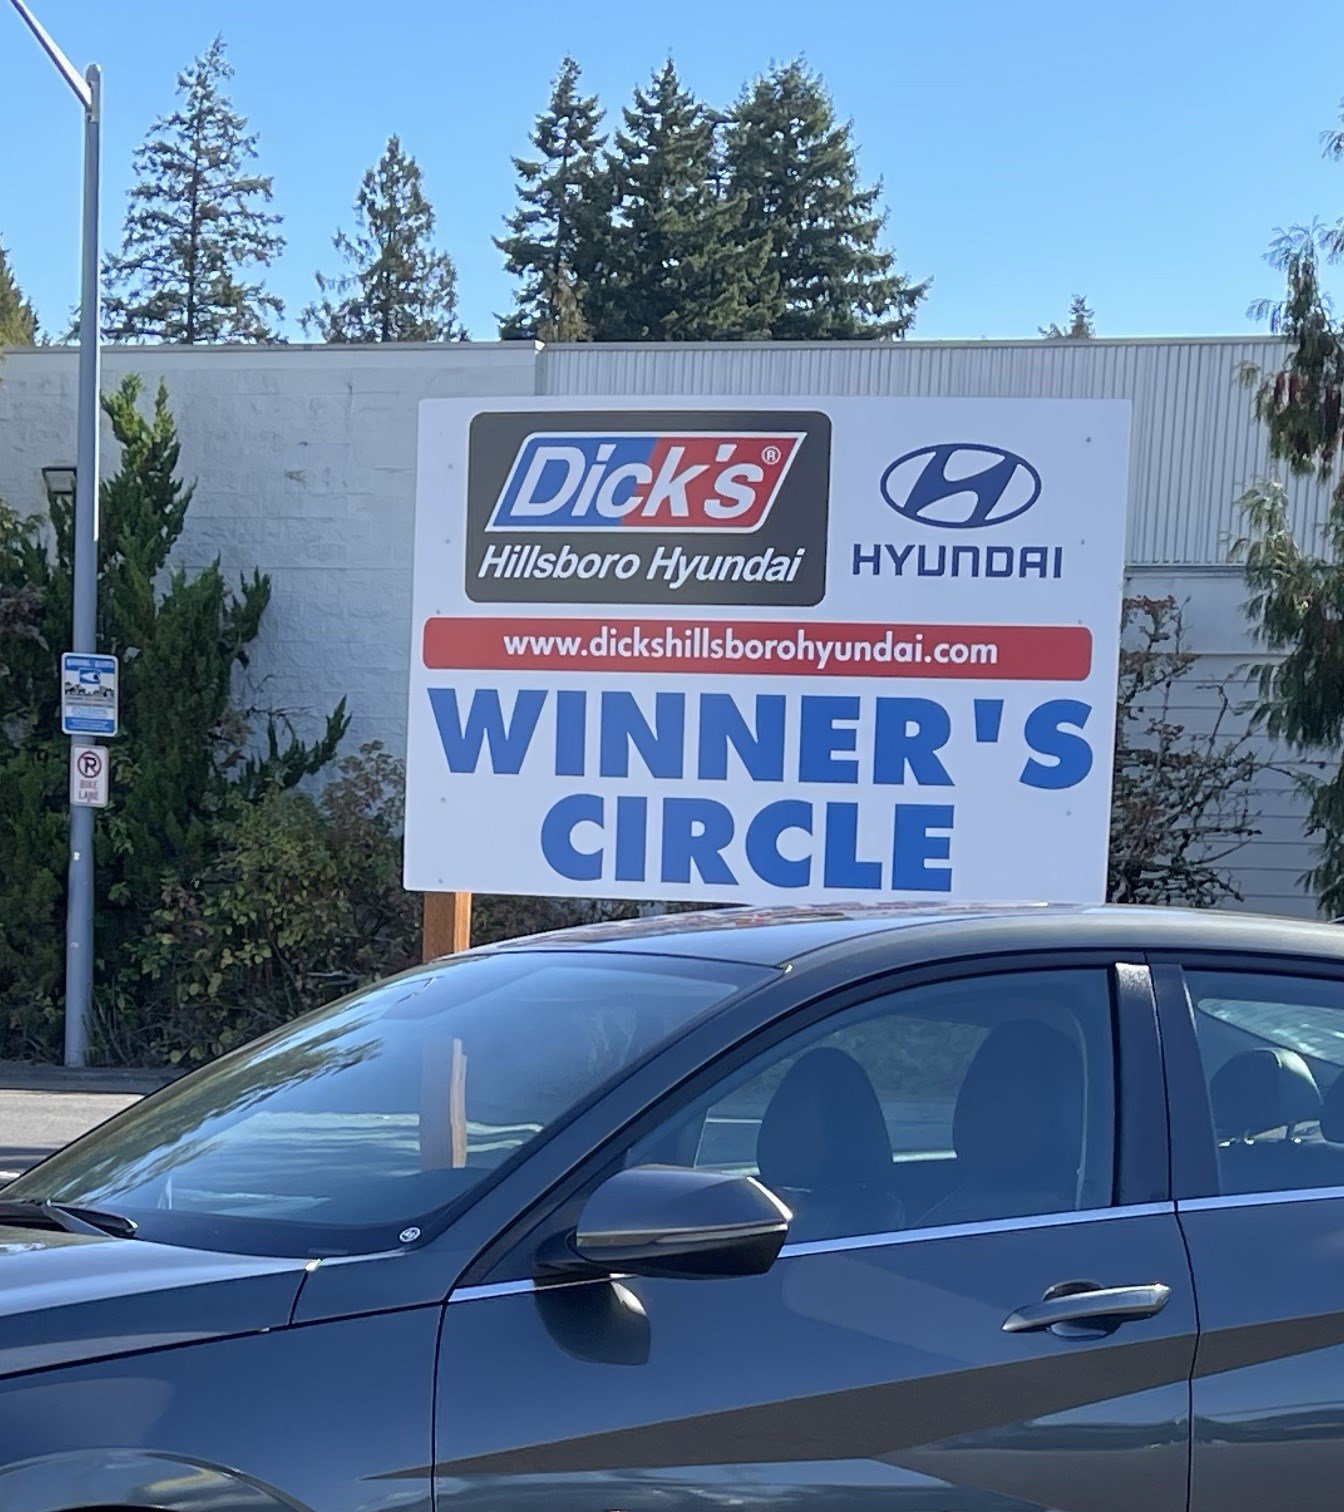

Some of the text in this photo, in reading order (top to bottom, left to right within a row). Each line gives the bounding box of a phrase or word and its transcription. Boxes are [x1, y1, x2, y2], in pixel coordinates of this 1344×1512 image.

[510, 443, 764, 519] Dick's
[478, 545, 805, 590] Hillsboro Hyundai
[853, 543, 1063, 579] HYUNDAI
[504, 627, 999, 670] www.dickshillsborohyundai.com
[428, 687, 1094, 790] WINNER'S
[540, 794, 955, 893] CIRCLE
